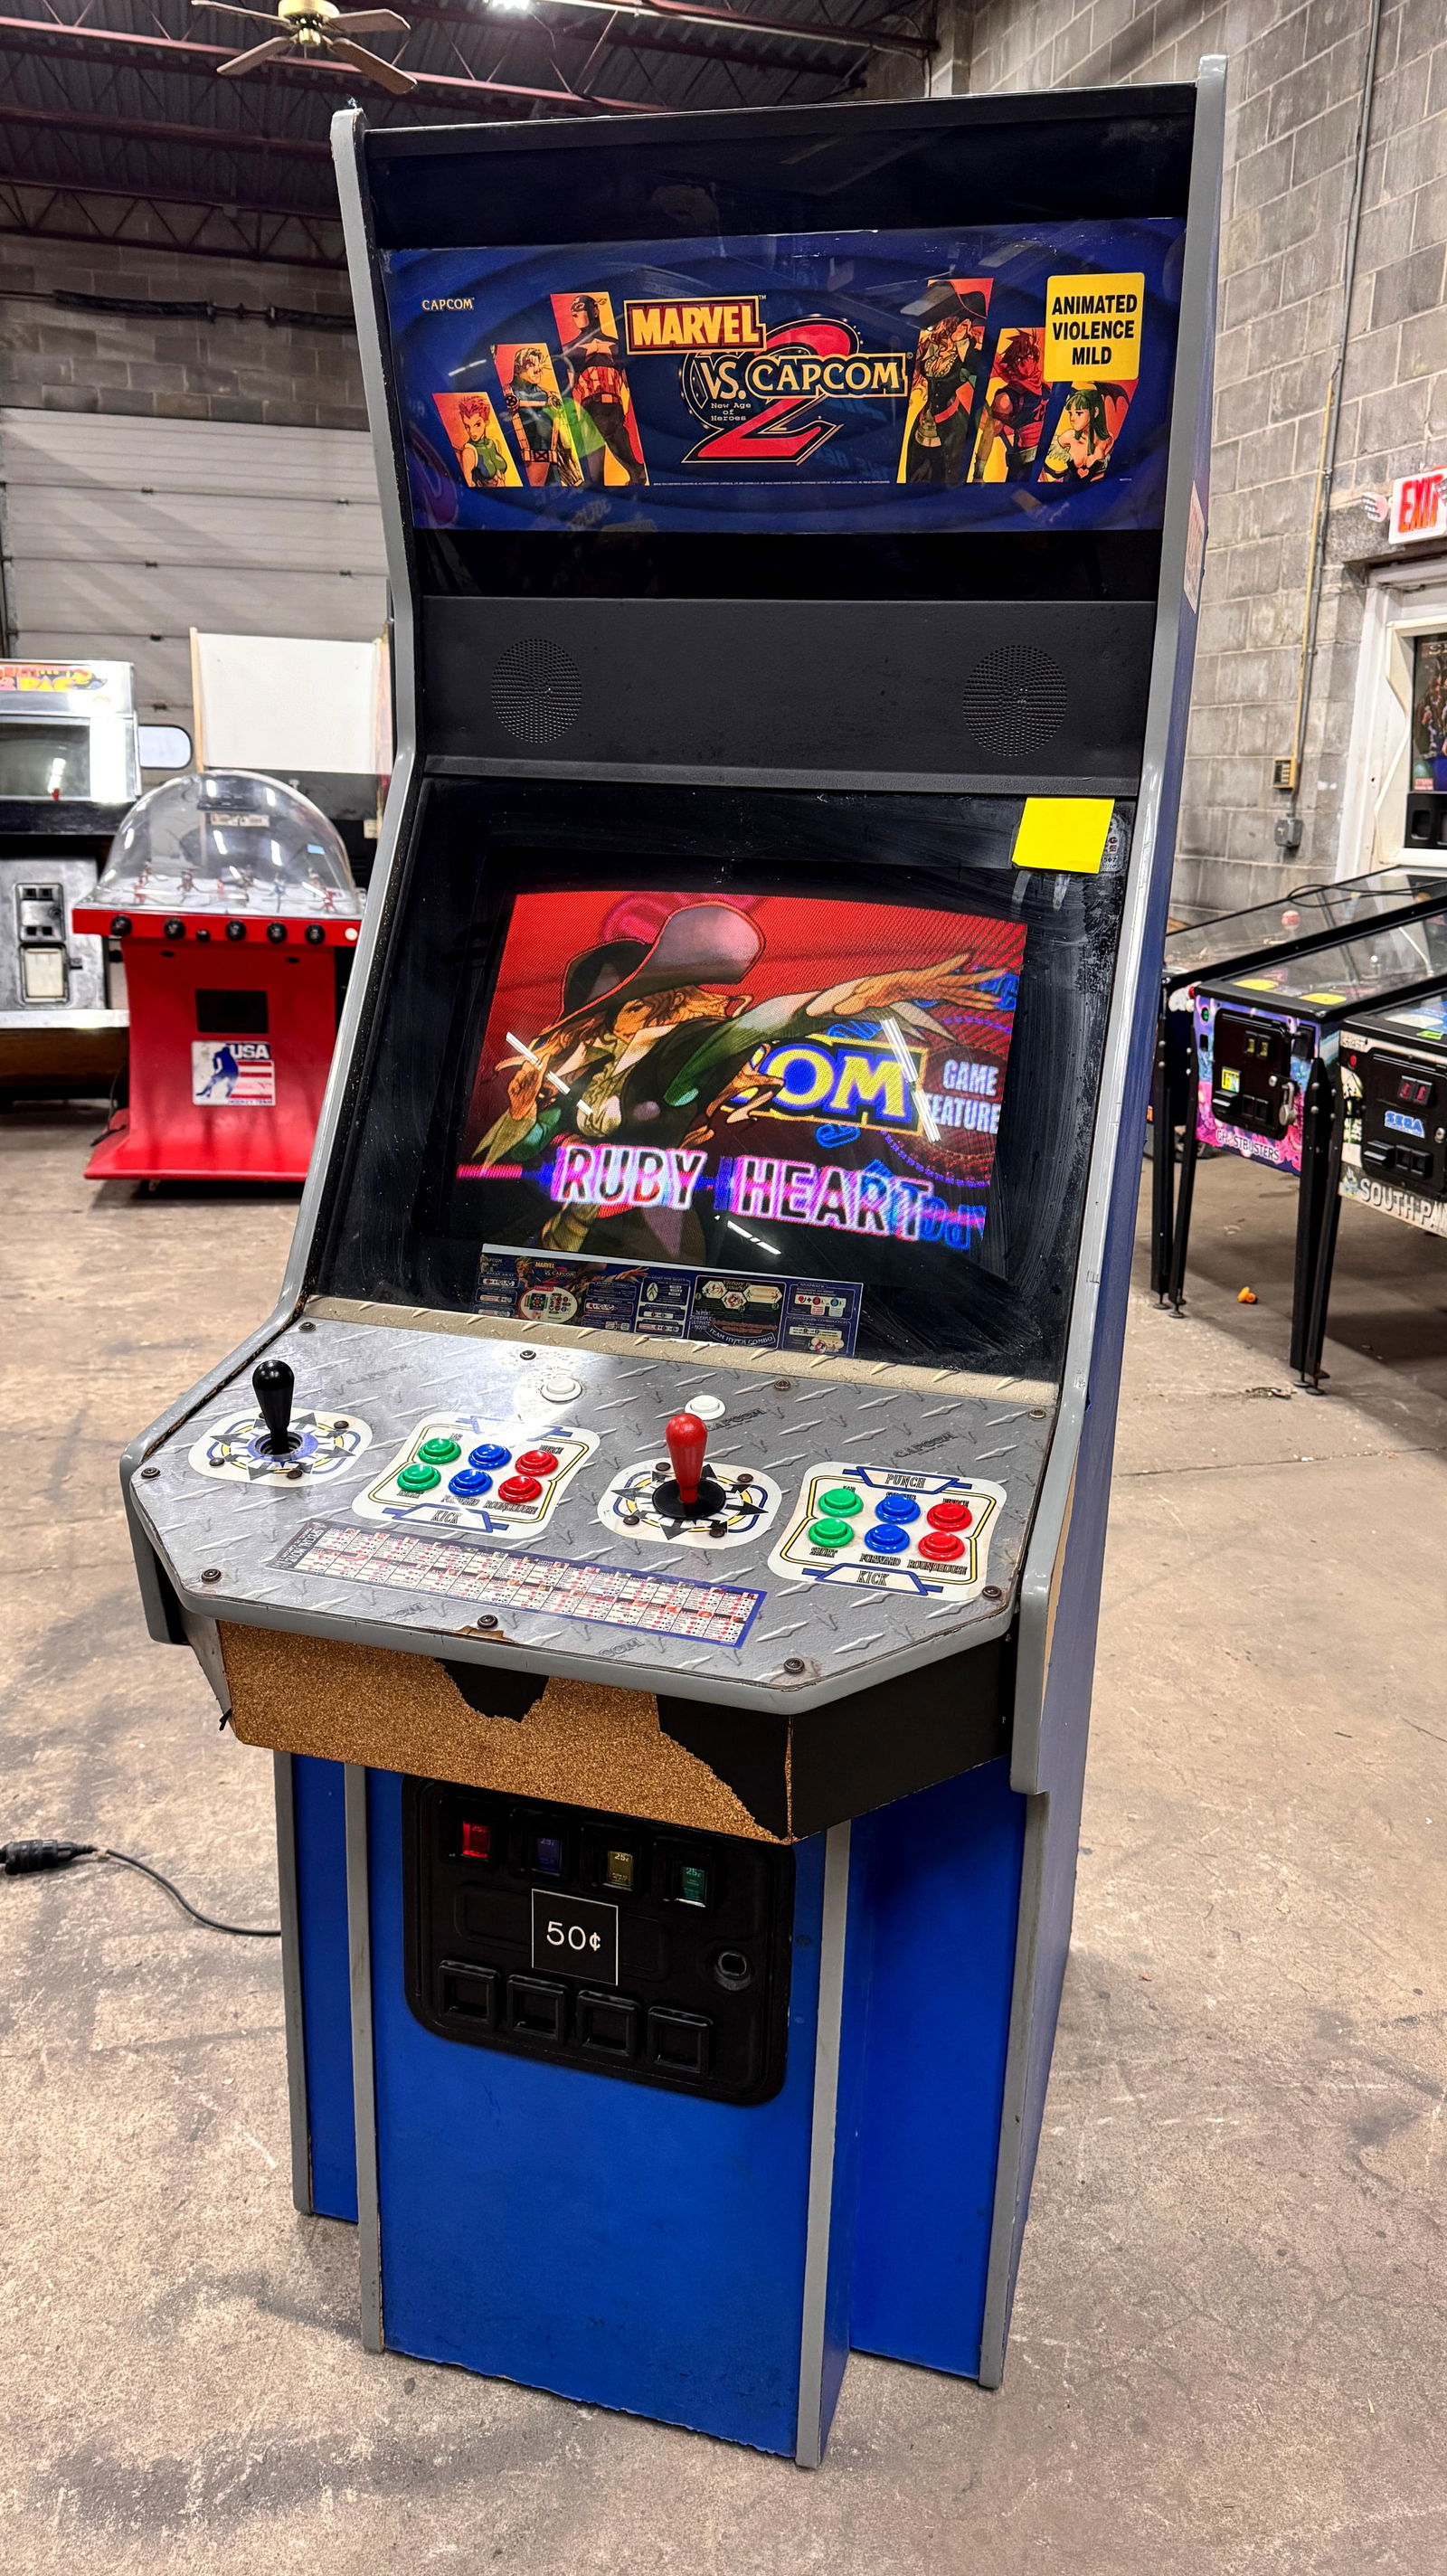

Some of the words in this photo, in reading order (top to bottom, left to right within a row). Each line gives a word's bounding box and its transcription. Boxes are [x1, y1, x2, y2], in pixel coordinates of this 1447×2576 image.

[421, 298, 473, 310] CAPCOM
[1052, 294, 1138, 315] ANIMATED
[632, 304, 760, 346] MARVEL
[1052, 320, 1135, 340] VIOLENCE
[1072, 346, 1112, 365] MILD
[700, 361, 746, 401] VS.
[752, 361, 901, 393] CAPCOM
[1398, 474, 1443, 533] EXIT
[230, 1044, 270, 1059] USA
[943, 1059, 998, 1096] GAME
[1386, 1113, 1423, 1132] SEGA
[553, 1144, 707, 1210] RUBY
[733, 1155, 933, 1241] HEART
[1360, 1178, 1415, 1221] SOUTH
[885, 1473, 926, 1489] PUNCH
[430, 1510, 463, 1524] KICK
[809, 1547, 838, 1558] SHORT
[860, 1553, 902, 1566] FORWARD
[907, 1559, 968, 1575] ROUNDHOUSE
[856, 1570, 889, 1586] KICK
[546, 1920, 601, 1952] 50¢
